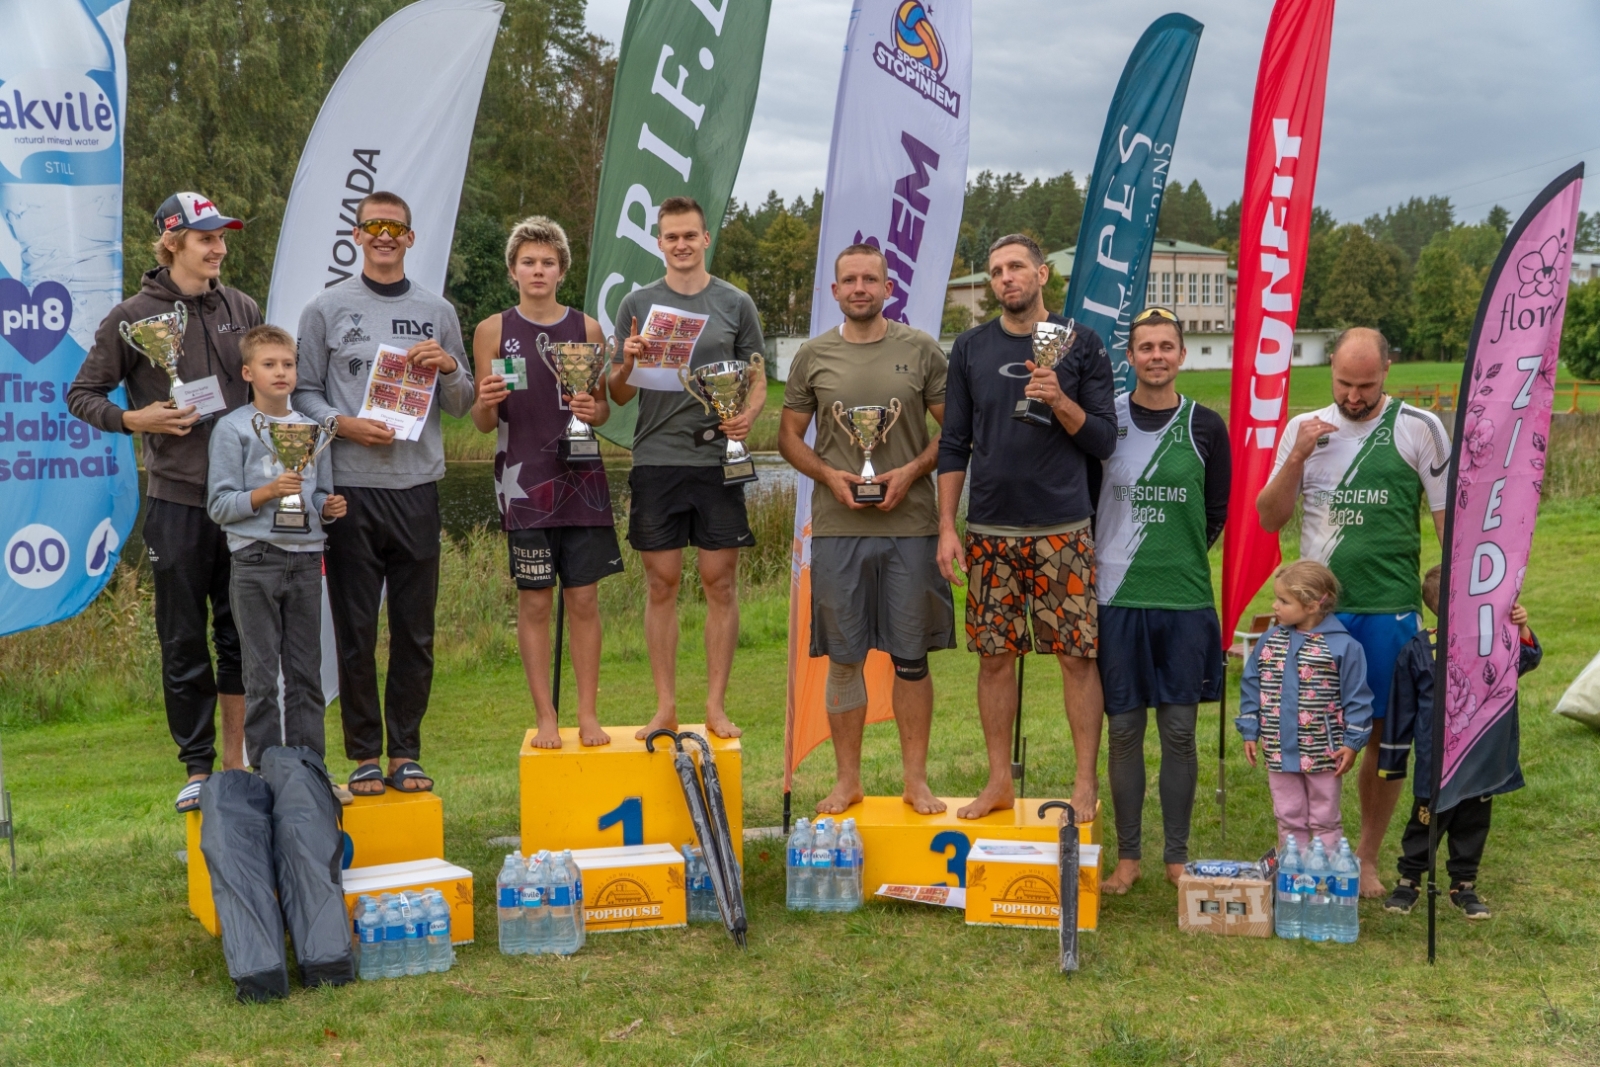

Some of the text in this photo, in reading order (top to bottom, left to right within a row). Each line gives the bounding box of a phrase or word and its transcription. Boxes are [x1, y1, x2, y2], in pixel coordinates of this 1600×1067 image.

[896, 49, 938, 82] SPORTS
[0, 89, 112, 132] akvilė
[14, 136, 45, 144] natural
[47, 136, 73, 146] mineral
[45, 161, 75, 175] STILL
[1172, 425, 1184, 442] 1
[1375, 427, 1391, 445] 2
[1113, 486, 1187, 502] UPESCIEMS
[1313, 489, 1389, 507] UPESCIEMS
[1131, 507, 1166, 523] 2026
[1328, 510, 1364, 526] 2026
[10, 538, 65, 574] 0.0
[513, 546, 551, 558] STELPES
[598, 796, 644, 846] 1
[930, 830, 971, 888] 3
[585, 905, 661, 921] POPHOUSE
[992, 902, 1060, 917] POPHOUS
